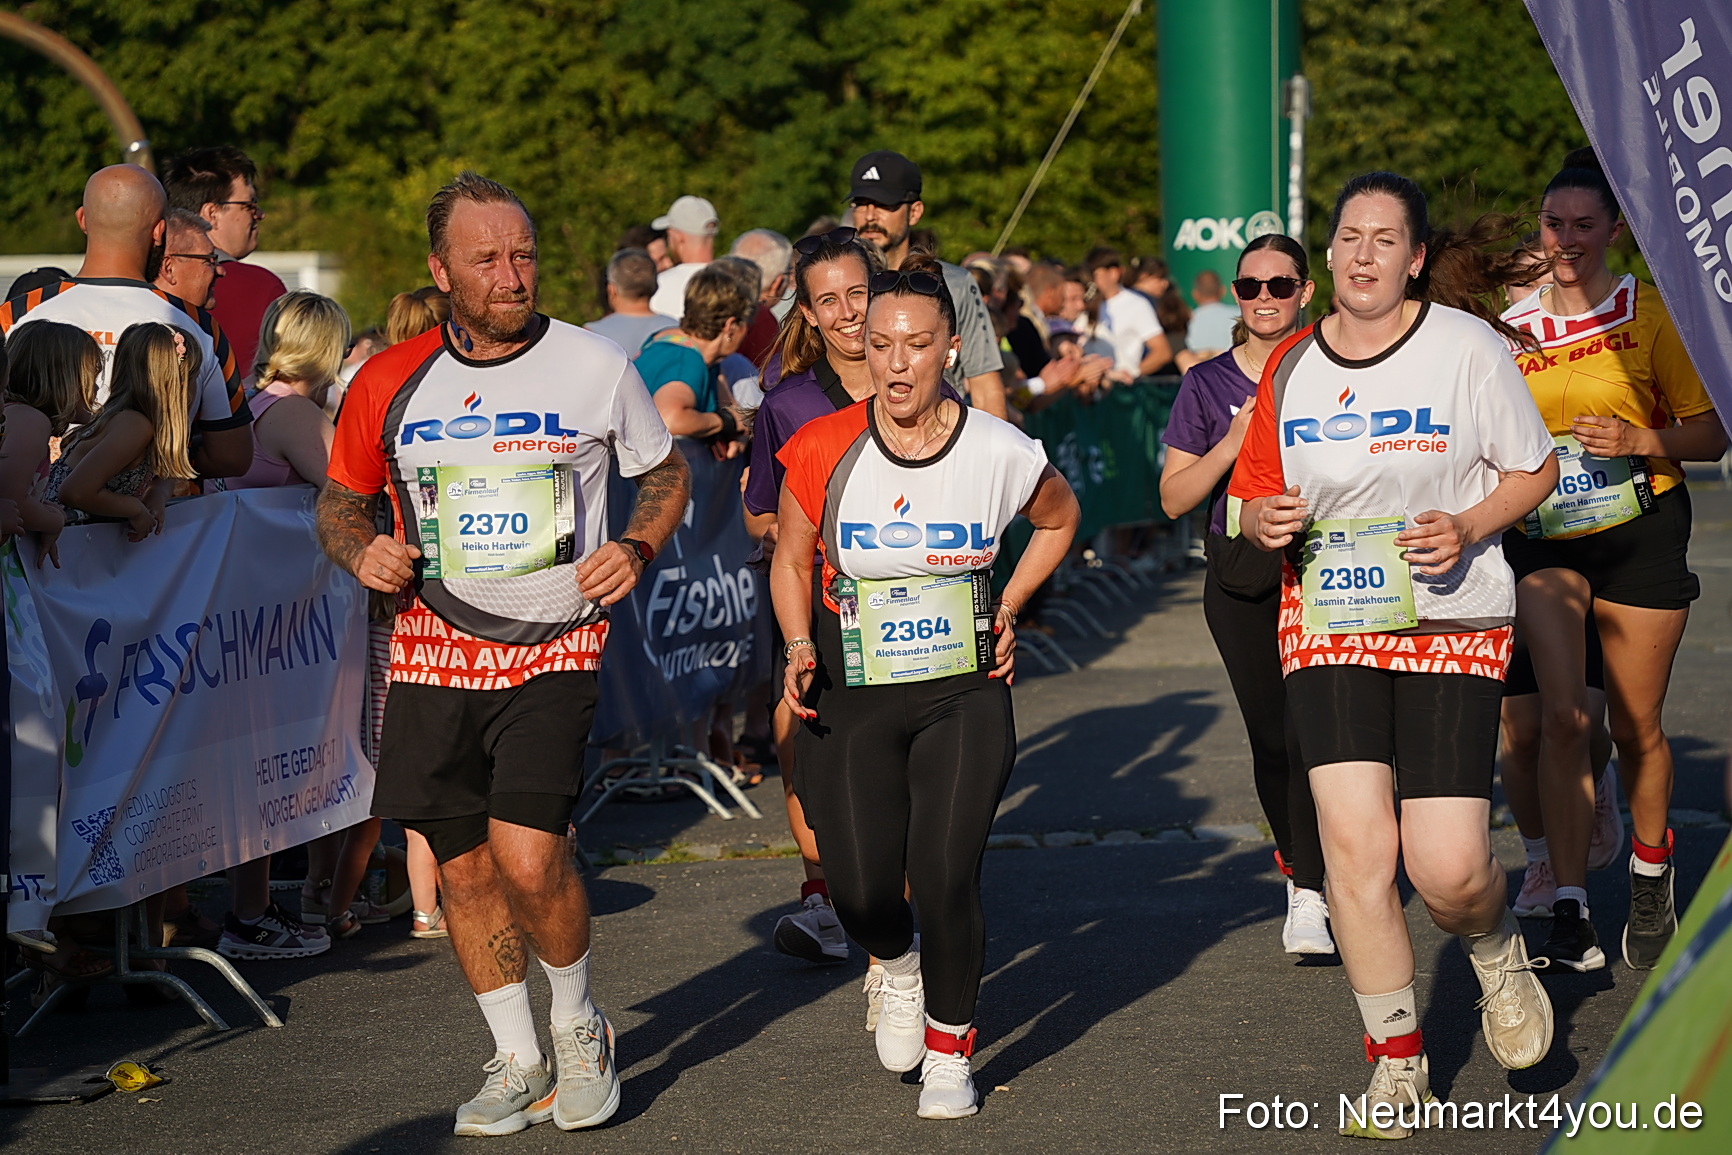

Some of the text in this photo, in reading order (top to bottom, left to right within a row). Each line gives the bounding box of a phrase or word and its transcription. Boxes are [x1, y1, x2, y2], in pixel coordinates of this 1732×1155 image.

[1173, 217, 1247, 252] AOK
[1569, 331, 1639, 363] BÖGL
[493, 434, 578, 454] energie
[1369, 431, 1448, 454] energie
[464, 486, 499, 496] Firmenlauf
[1556, 470, 1608, 496] 1690
[555, 504, 561, 513] 20
[1552, 500, 1576, 511] Helen
[1577, 493, 1621, 507] Hammerer
[1637, 485, 1651, 510] HILTL
[458, 512, 529, 536] 2370
[461, 541, 490, 551] Heiko
[558, 536, 567, 562] HILTL
[926, 547, 994, 567] energie
[1325, 540, 1356, 550] Firmenlauf
[1319, 566, 1385, 591] 2380
[645, 553, 758, 642] Fische
[885, 594, 921, 605] Firmenlauf
[973, 604, 980, 614] 20
[1313, 595, 1401, 607] Jasmin Zwakhoven
[880, 616, 952, 643] 2364
[875, 641, 965, 658] Aleksandra Arsova
[978, 632, 988, 664] HILTL
[254, 752, 290, 787] HEUTE
[153, 778, 198, 810] LOGISTICS
[259, 774, 360, 830] MORGEN GEMACHT.
[124, 803, 204, 847] CORPORATE PRINT
[134, 826, 217, 873] CORPORATE SIGNAGE
[1382, 1011, 1412, 1025] adidas
